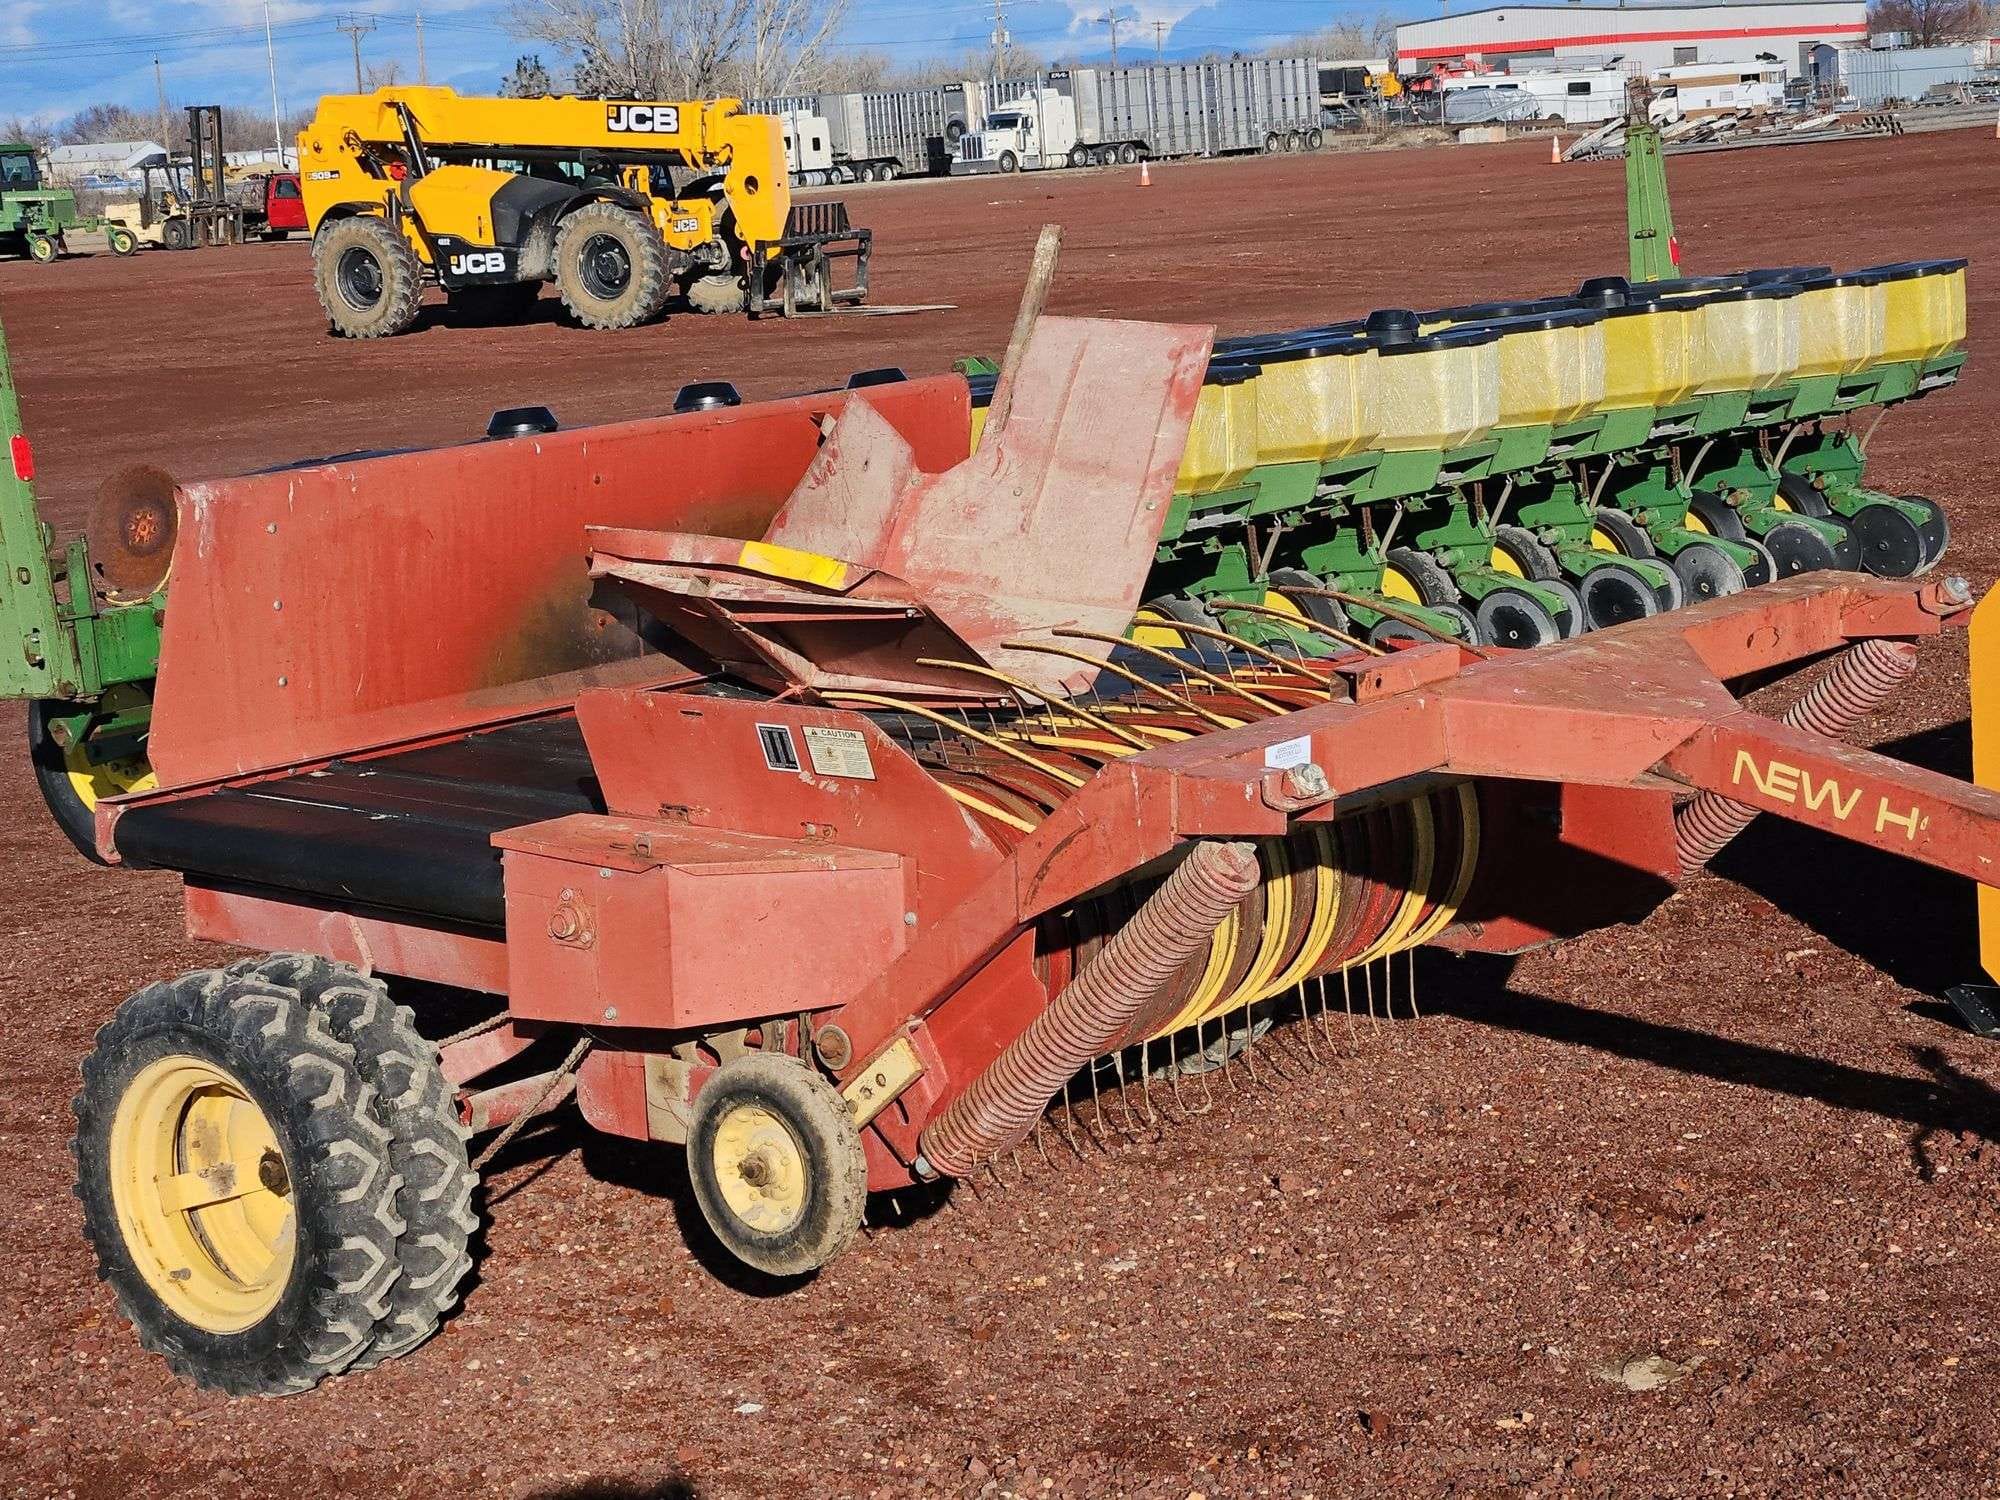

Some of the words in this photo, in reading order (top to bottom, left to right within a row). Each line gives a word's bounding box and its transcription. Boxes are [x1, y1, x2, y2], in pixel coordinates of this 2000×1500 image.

[608, 106, 678, 132] JCB
[673, 218, 698, 232] JCB
[450, 252, 506, 275] JCB
[821, 729, 857, 739] CAUTION
[1732, 750, 1863, 821] NEW
[1875, 797, 1930, 841] H
